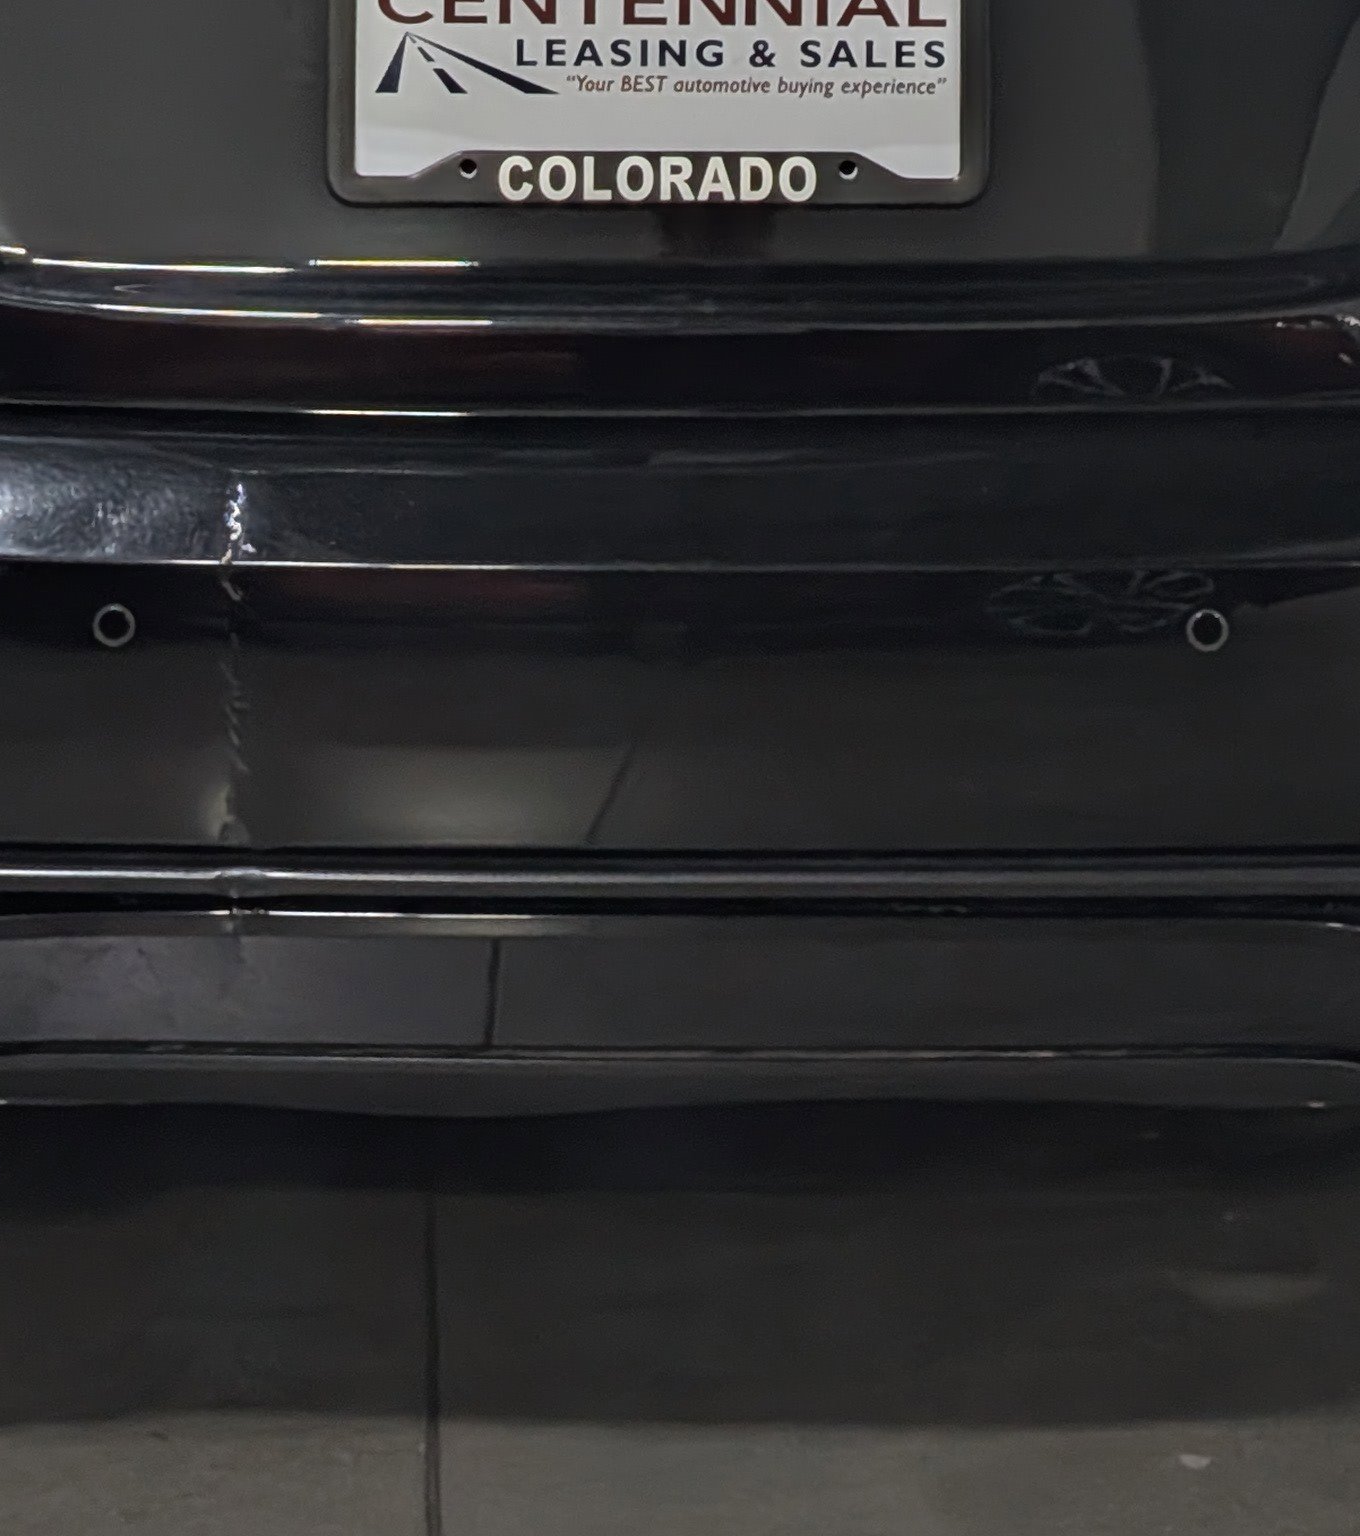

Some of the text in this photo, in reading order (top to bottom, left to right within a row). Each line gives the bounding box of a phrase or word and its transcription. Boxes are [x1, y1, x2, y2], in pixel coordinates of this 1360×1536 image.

[515, 38, 946, 68] LEASING & SALES
[620, 74, 668, 93] BEST
[673, 75, 771, 94] automotive
[777, 76, 835, 99] buying
[498, 154, 818, 203] COLORADO
